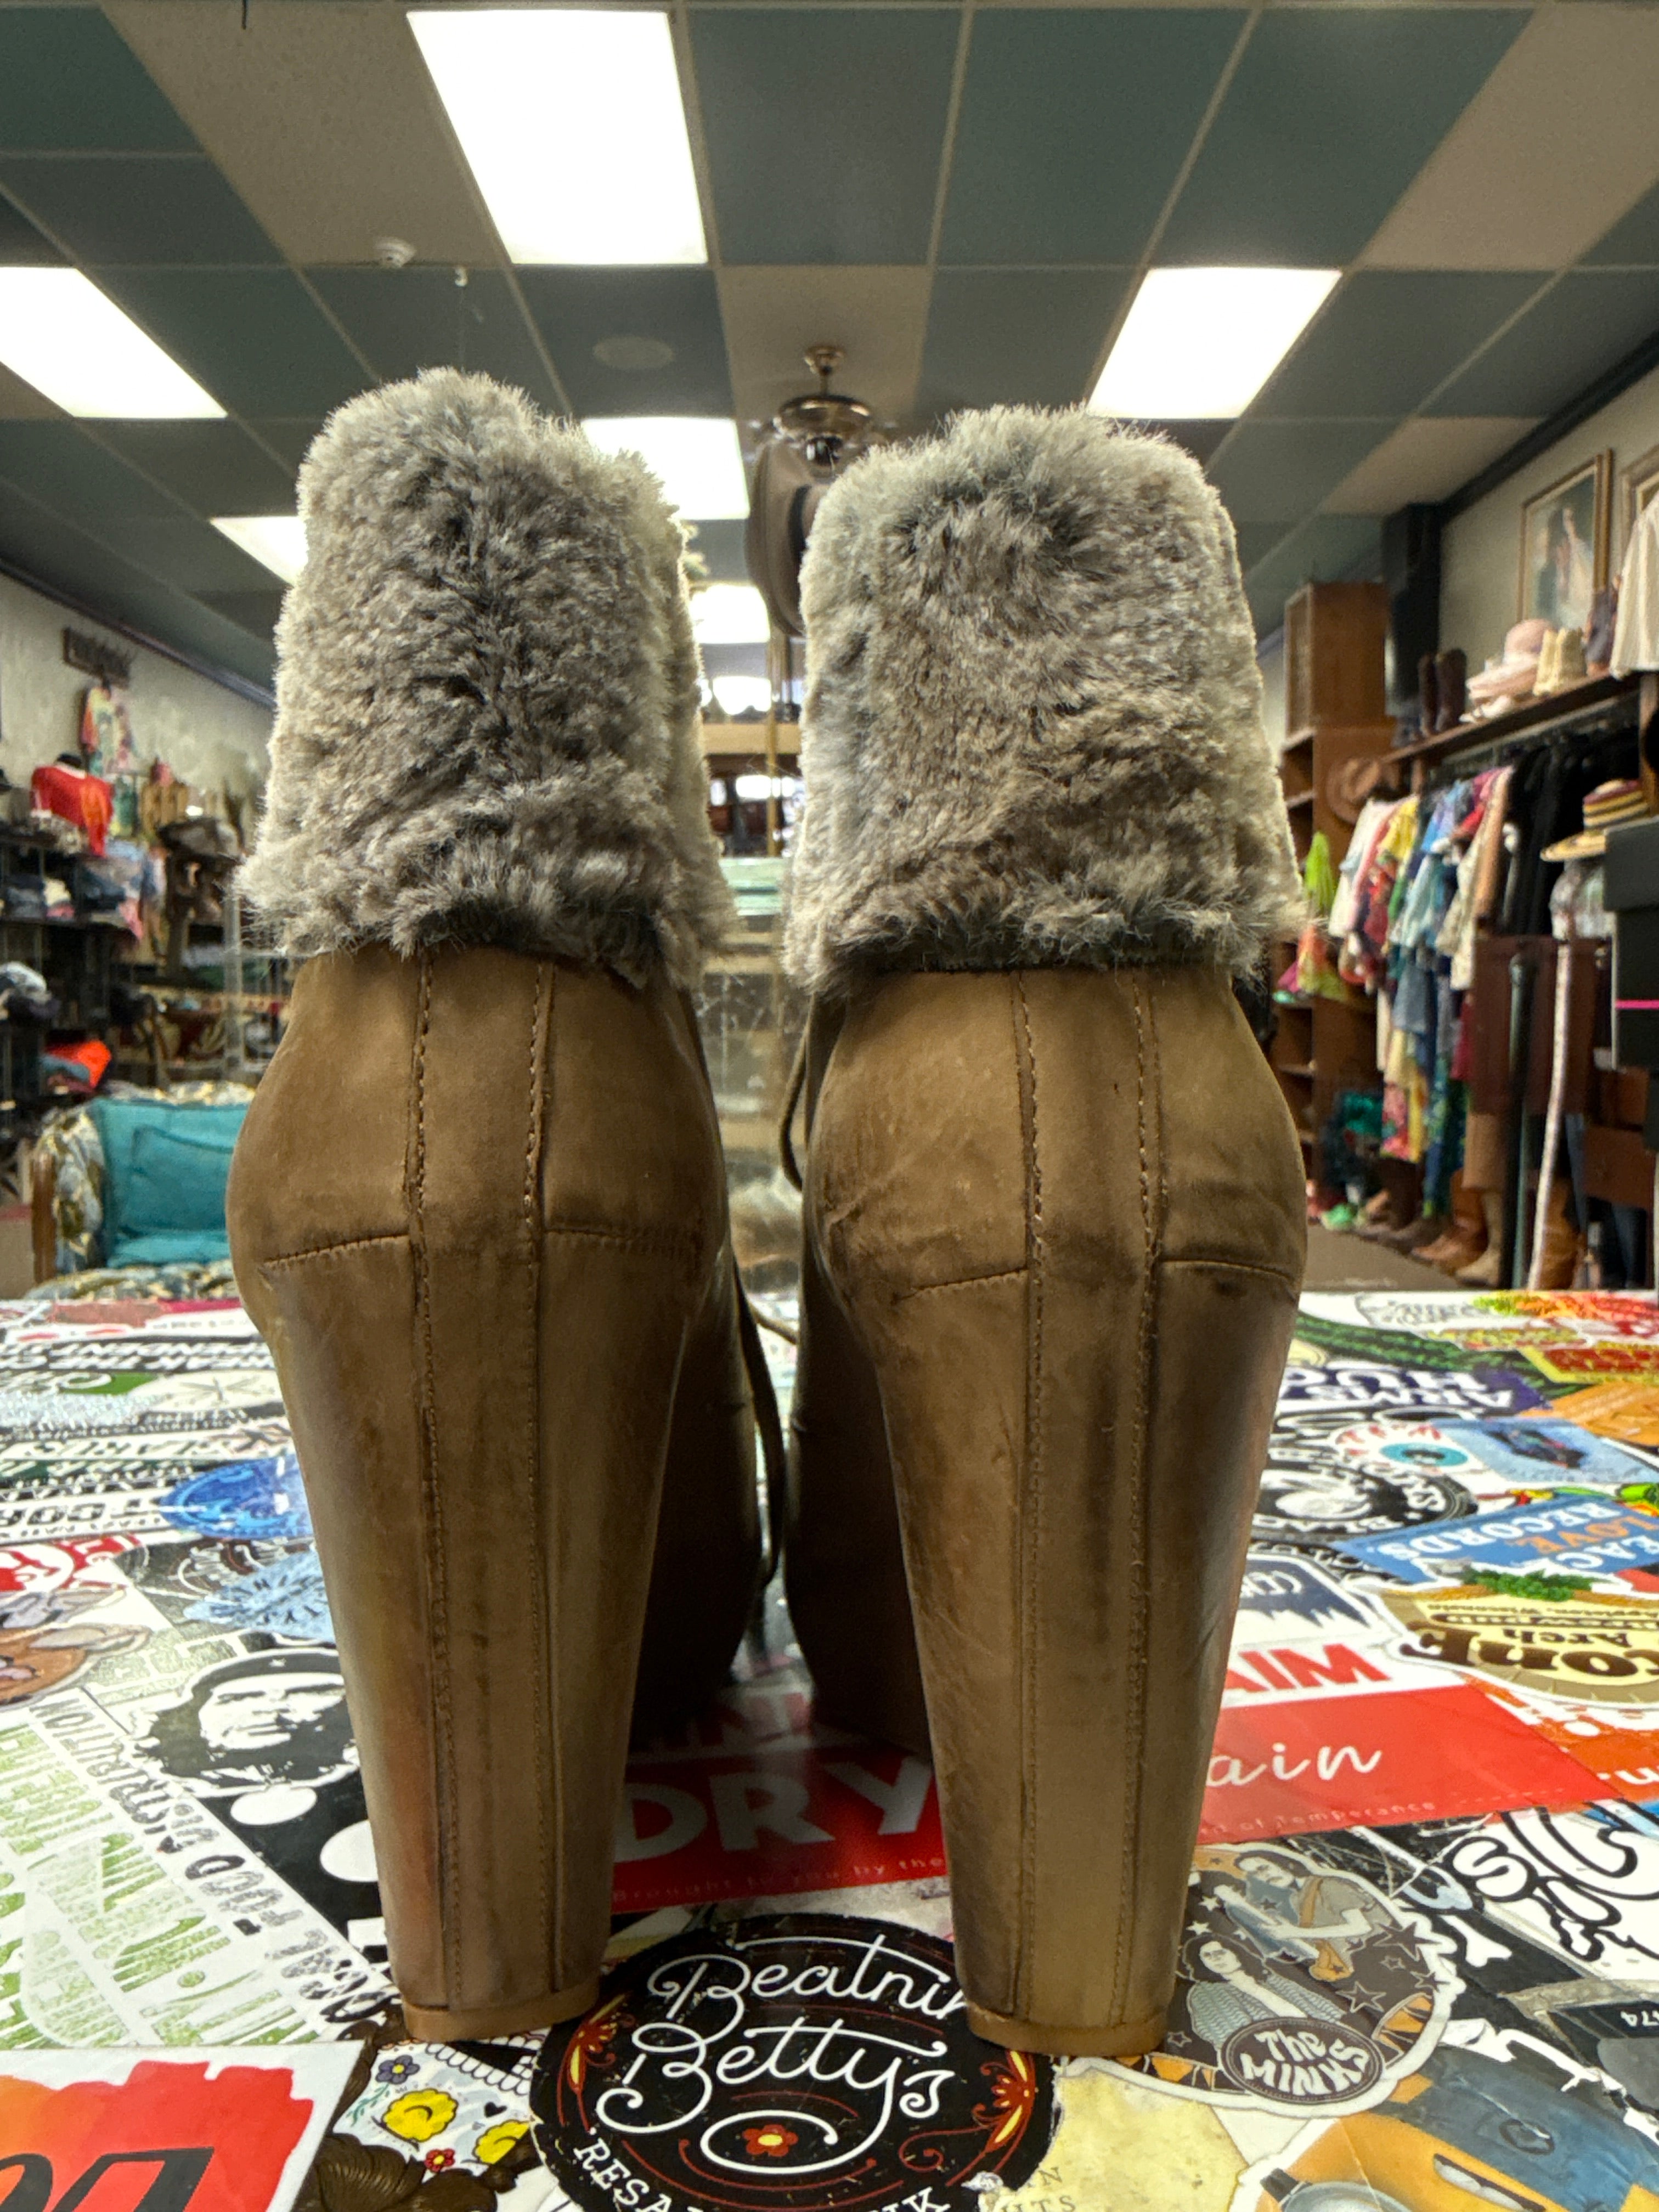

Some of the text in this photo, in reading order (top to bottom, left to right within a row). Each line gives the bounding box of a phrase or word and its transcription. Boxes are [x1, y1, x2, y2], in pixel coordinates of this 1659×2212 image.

[1554, 1536, 1659, 1570] EAC
[1503, 1628, 1632, 1649] Arch
[1206, 1742, 1383, 1787] ain
[853, 1865, 884, 1877] by
[265, 1928, 403, 2023] OCAL
[1254, 2028, 1327, 2062] The
[573, 2137, 705, 2212] RESA
